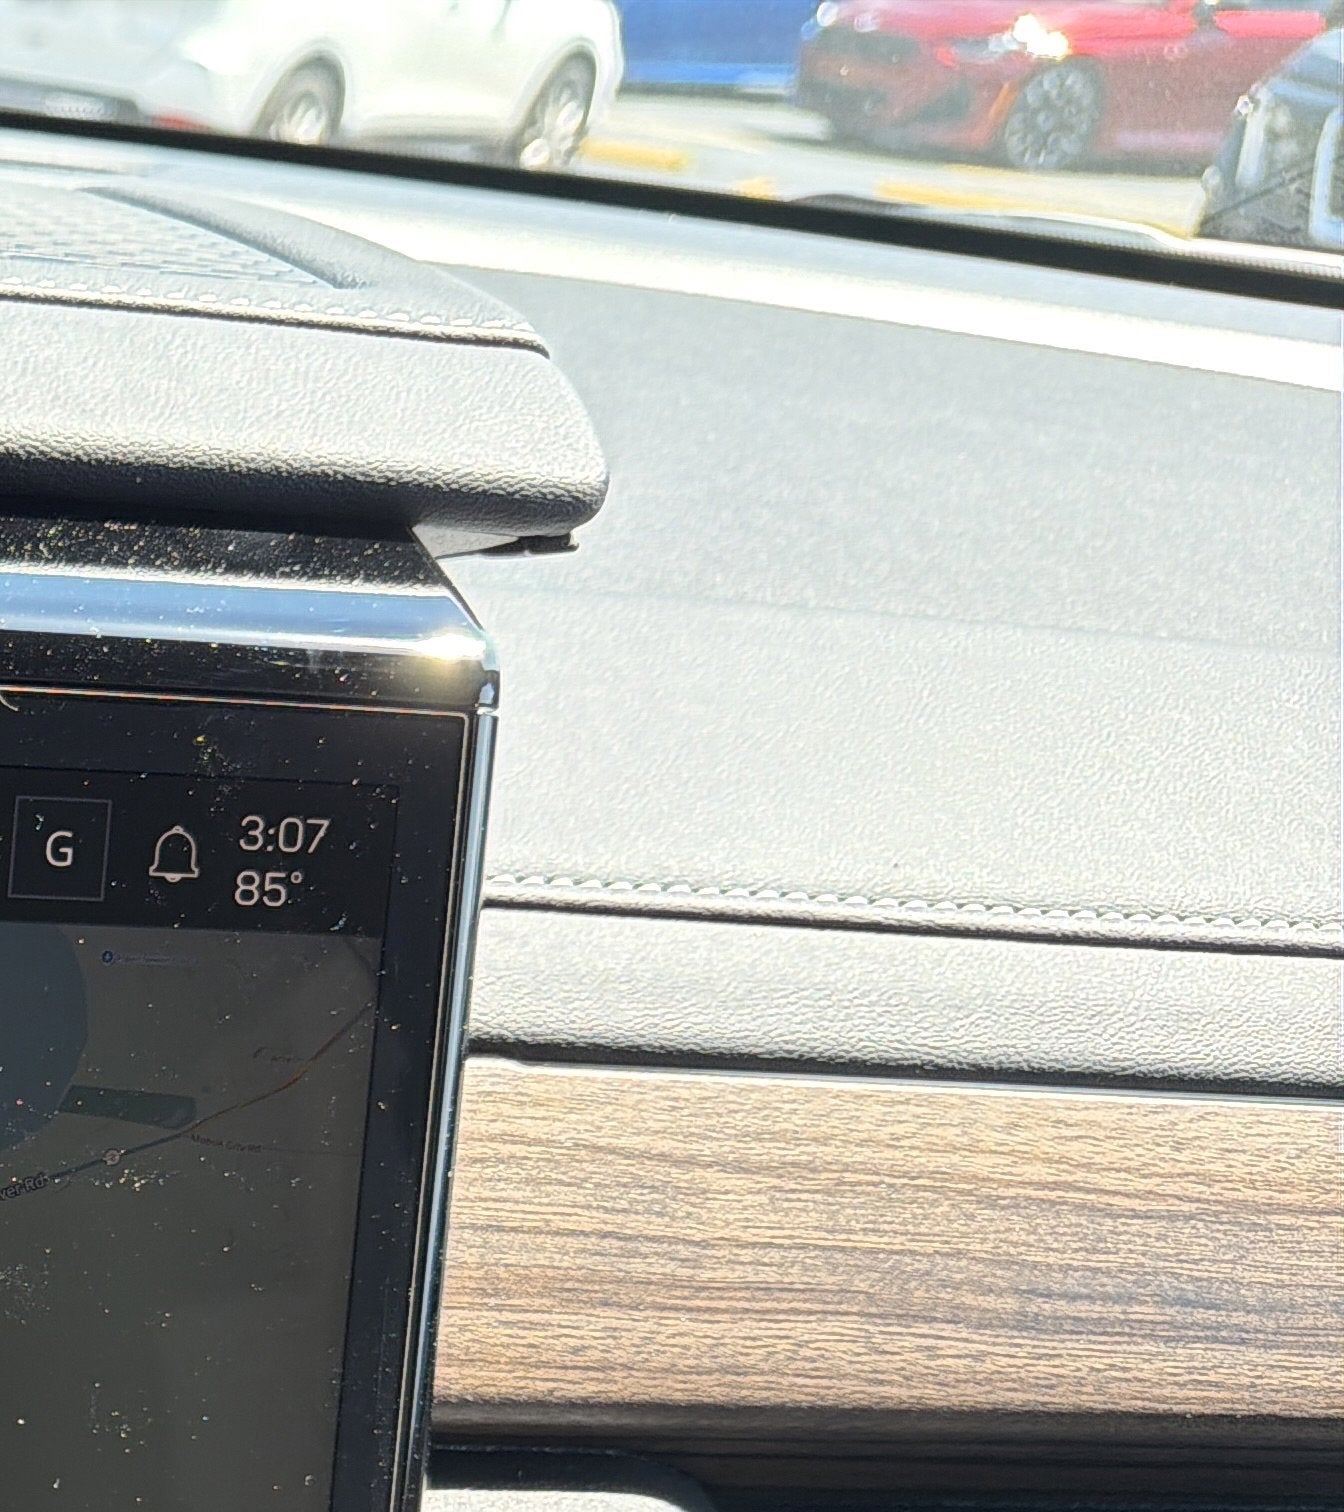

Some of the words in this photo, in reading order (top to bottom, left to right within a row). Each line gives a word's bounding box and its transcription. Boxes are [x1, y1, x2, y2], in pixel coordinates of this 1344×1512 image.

[45, 830, 75, 868] G
[238, 815, 331, 855] 3:07
[234, 870, 305, 908] 85°
[24, 1172, 45, 1192] Rd
